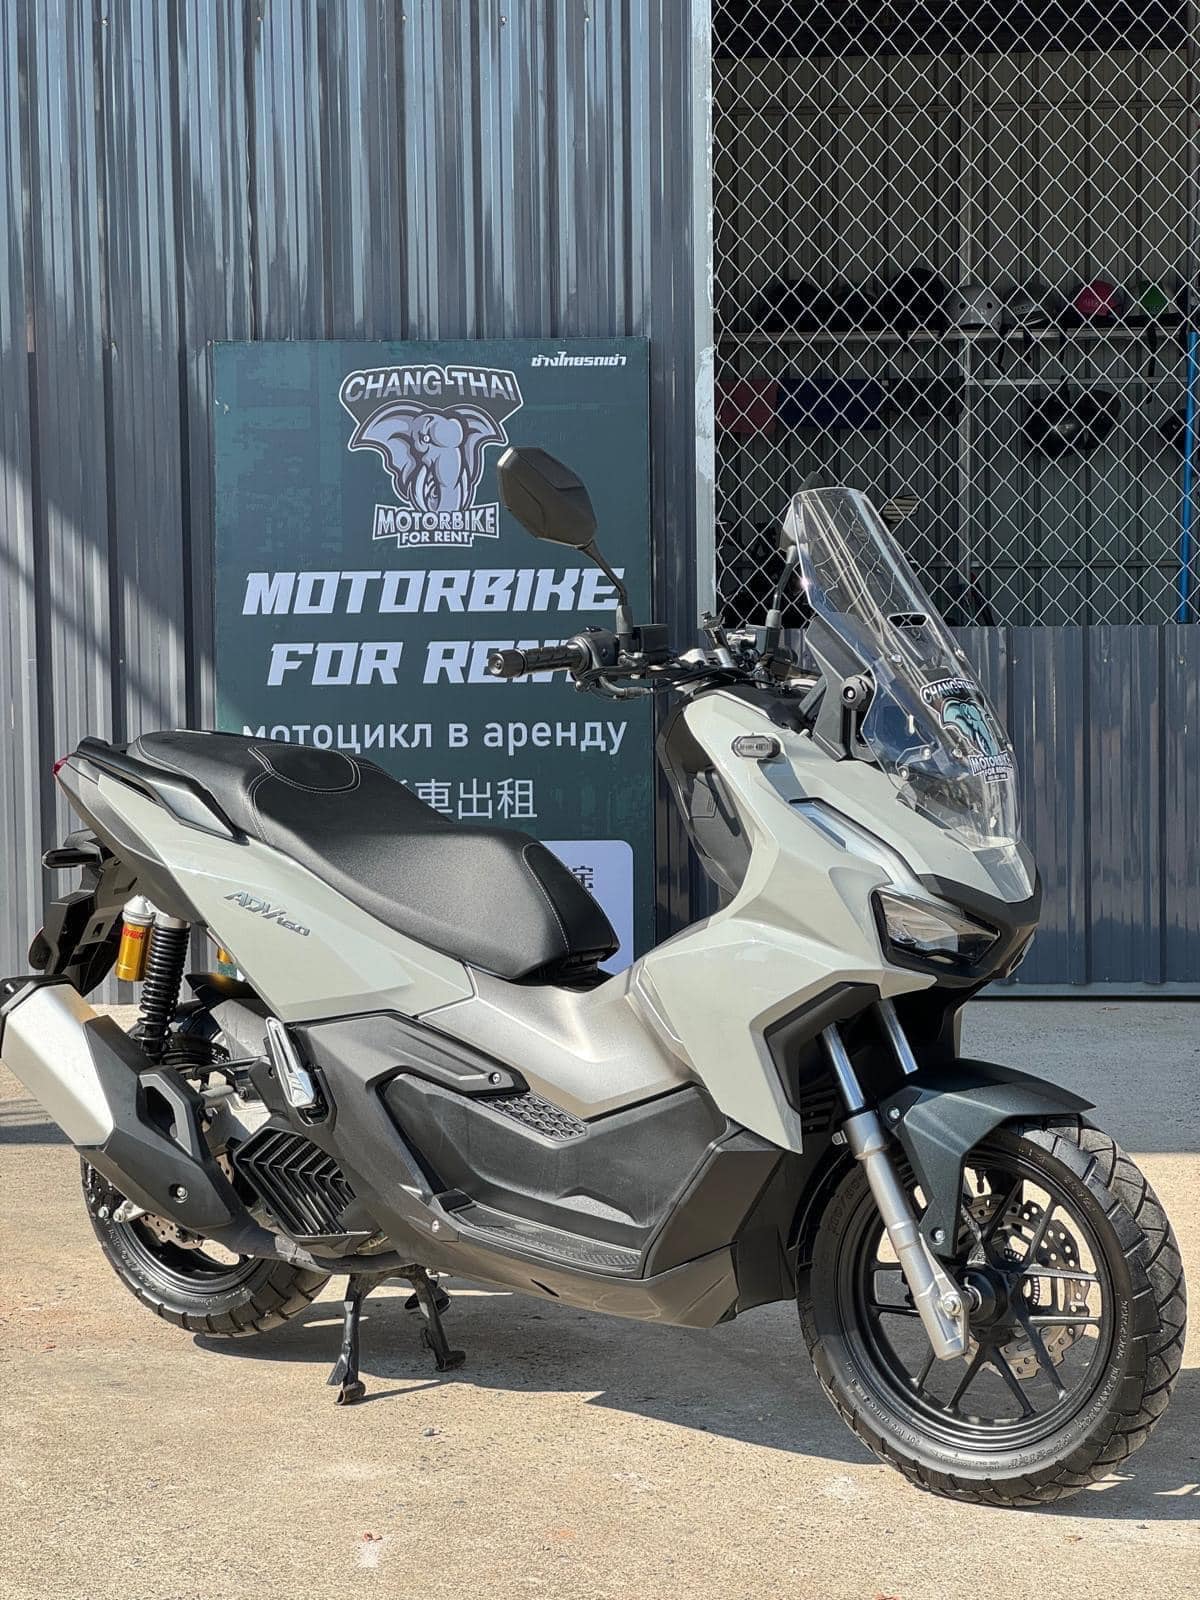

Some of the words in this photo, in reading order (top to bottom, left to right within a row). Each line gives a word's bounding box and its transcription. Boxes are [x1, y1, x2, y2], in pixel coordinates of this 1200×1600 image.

[376, 507, 496, 535] MOTORBIKE
[402, 532, 430, 544] FOR
[434, 531, 470, 543] RENT
[242, 567, 625, 616] MOTORBIKE
[267, 641, 403, 687] FOR
[448, 724, 469, 748] в
[483, 719, 628, 756] аренду
